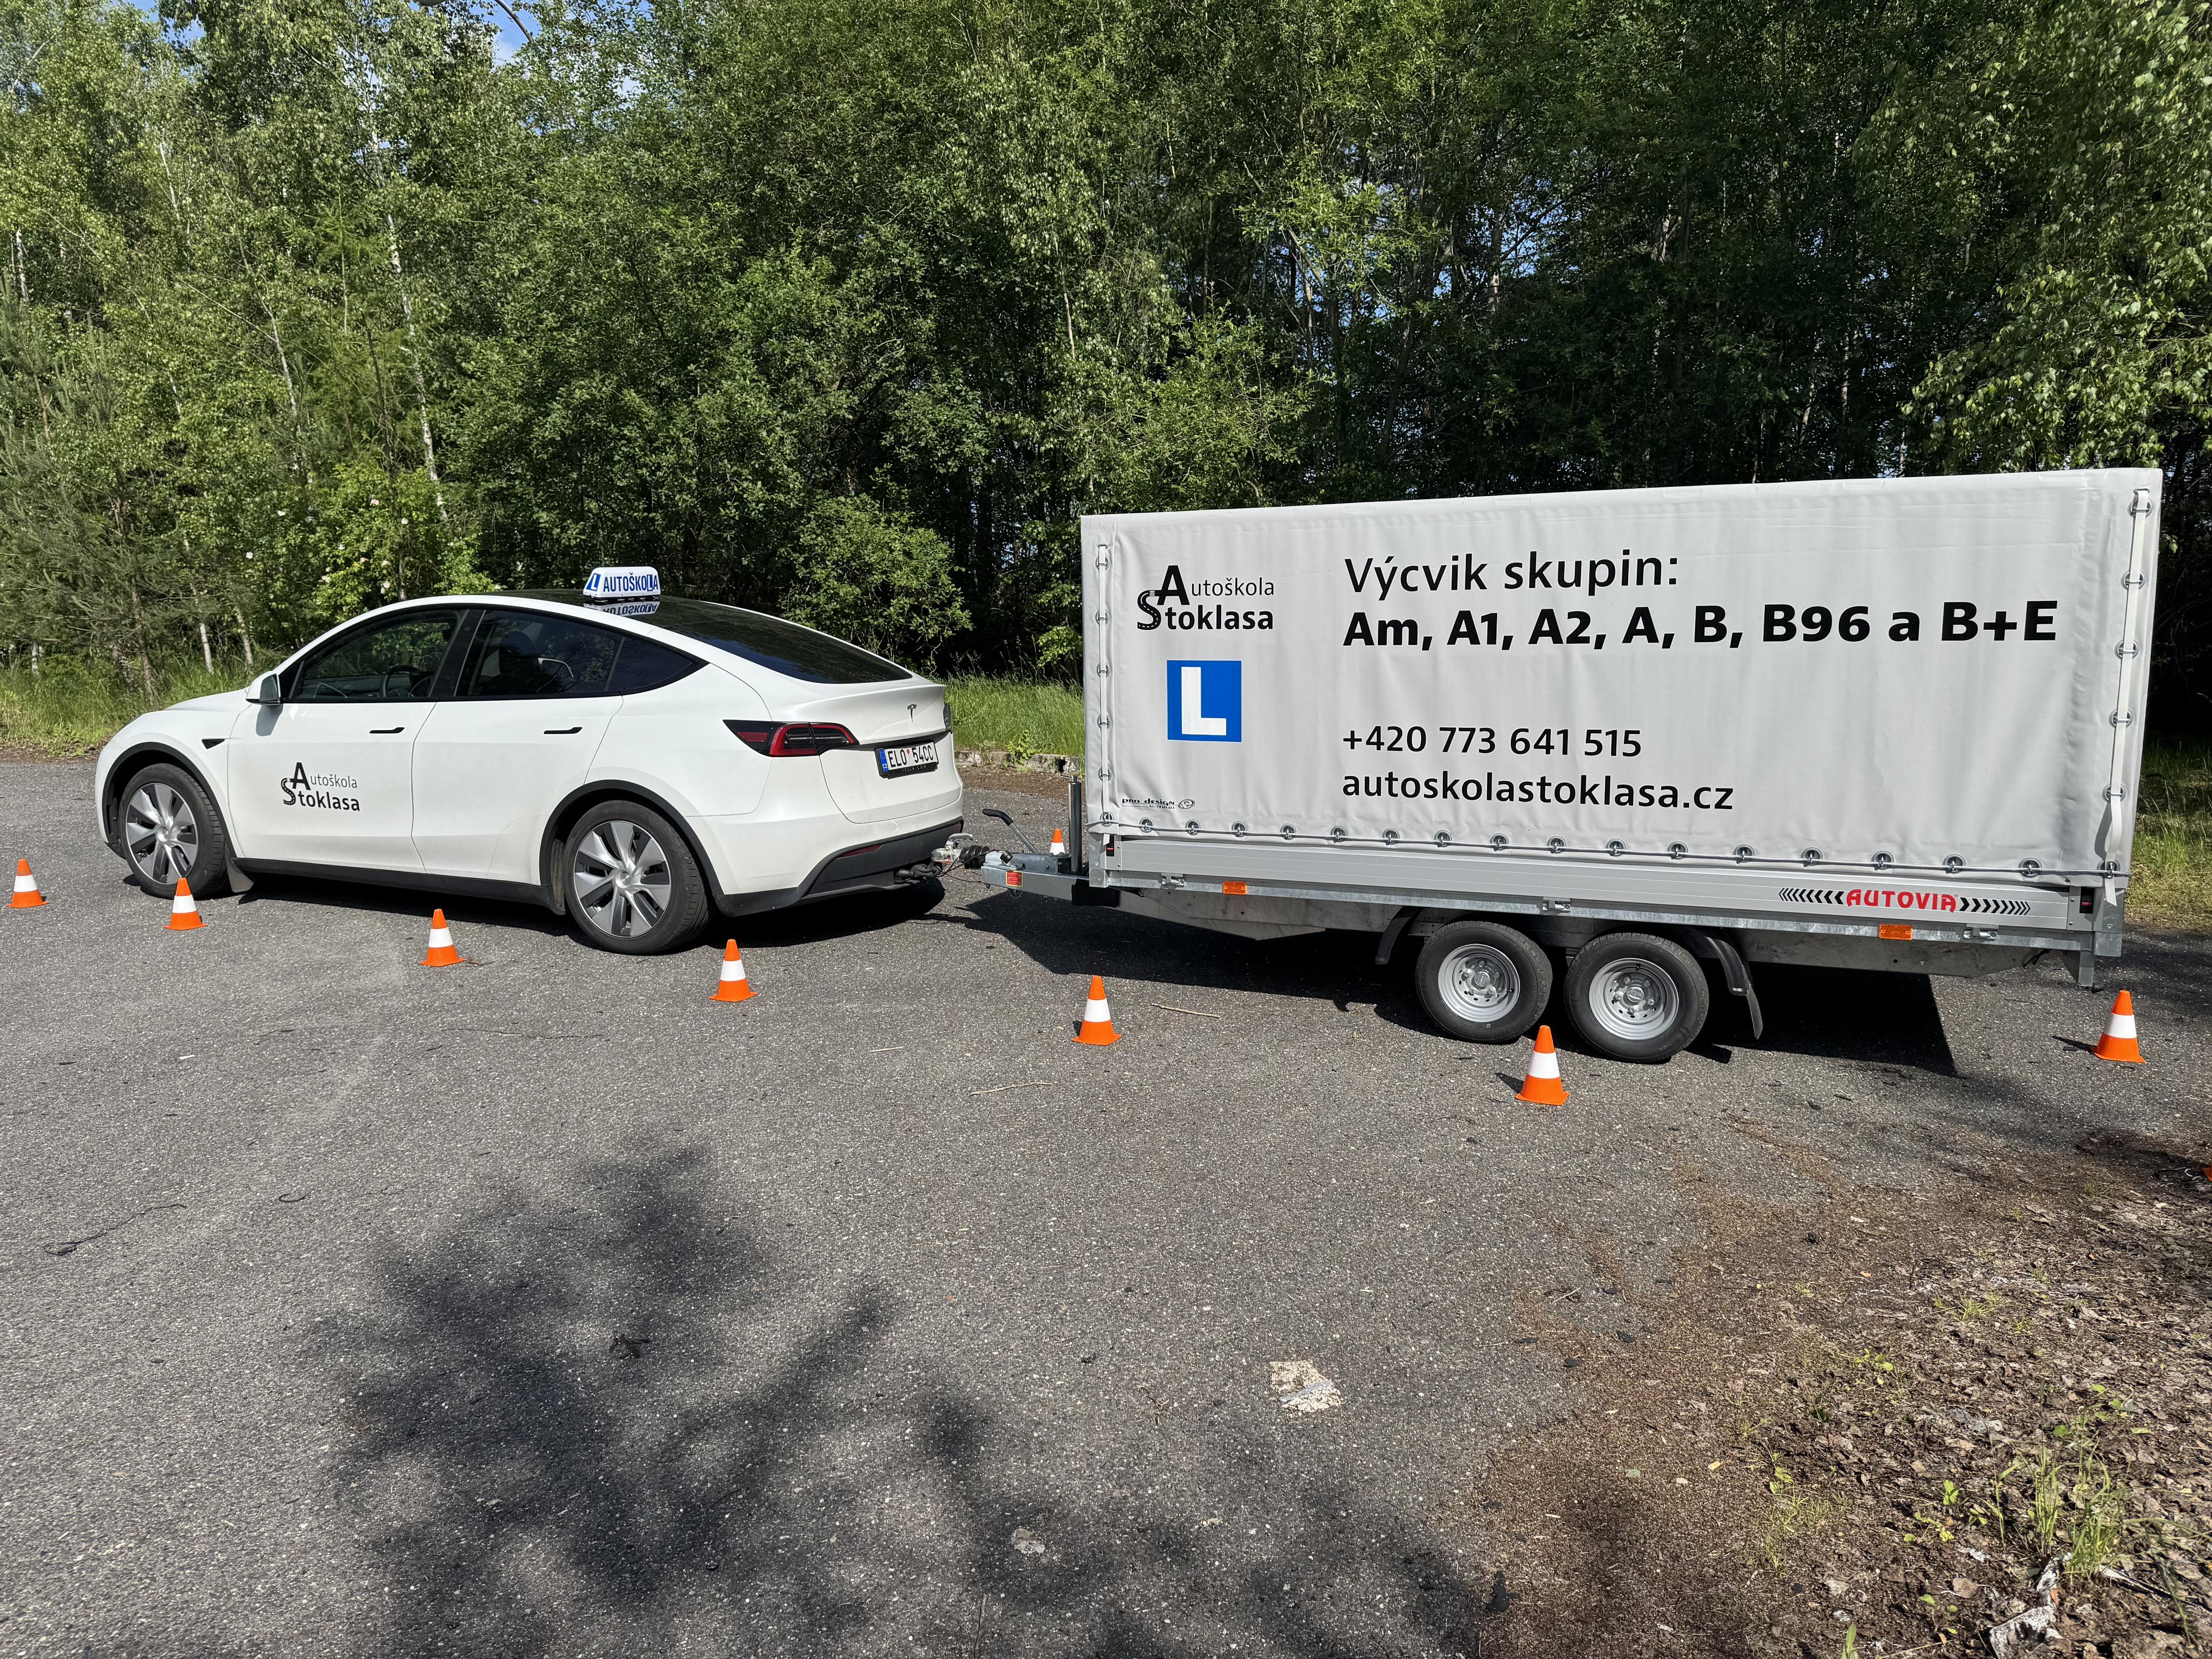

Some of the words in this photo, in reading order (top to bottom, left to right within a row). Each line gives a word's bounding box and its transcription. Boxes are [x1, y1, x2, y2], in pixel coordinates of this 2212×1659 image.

[603, 572, 659, 592] AUTOŠKOLA
[1157, 565, 1274, 606] Autoškola
[1345, 554, 1487, 601] Výcvik
[1505, 549, 1677, 596] skupin:
[1137, 589, 1274, 630] Stoklasa
[1343, 612, 1432, 650] Am,
[1447, 611, 1513, 650] A1,
[1528, 609, 1606, 649] A2,
[1622, 607, 1674, 649] A,
[1694, 606, 1743, 648] B,
[1763, 604, 1870, 641] B96
[1888, 612, 1919, 641] a
[1942, 601, 2057, 641] B+E
[911, 745, 934, 764] 54CC
[1343, 726, 1426, 752] +420
[1439, 727, 1495, 753] 773
[1511, 728, 1568, 755] 641
[1585, 729, 1641, 757] 515
[292, 762, 358, 791] Autoškola
[1343, 771, 1733, 809] autoskolastoklasa.cz
[281, 778, 360, 811] Stoklasa
[1847, 890, 1956, 912] AUTOVIA
